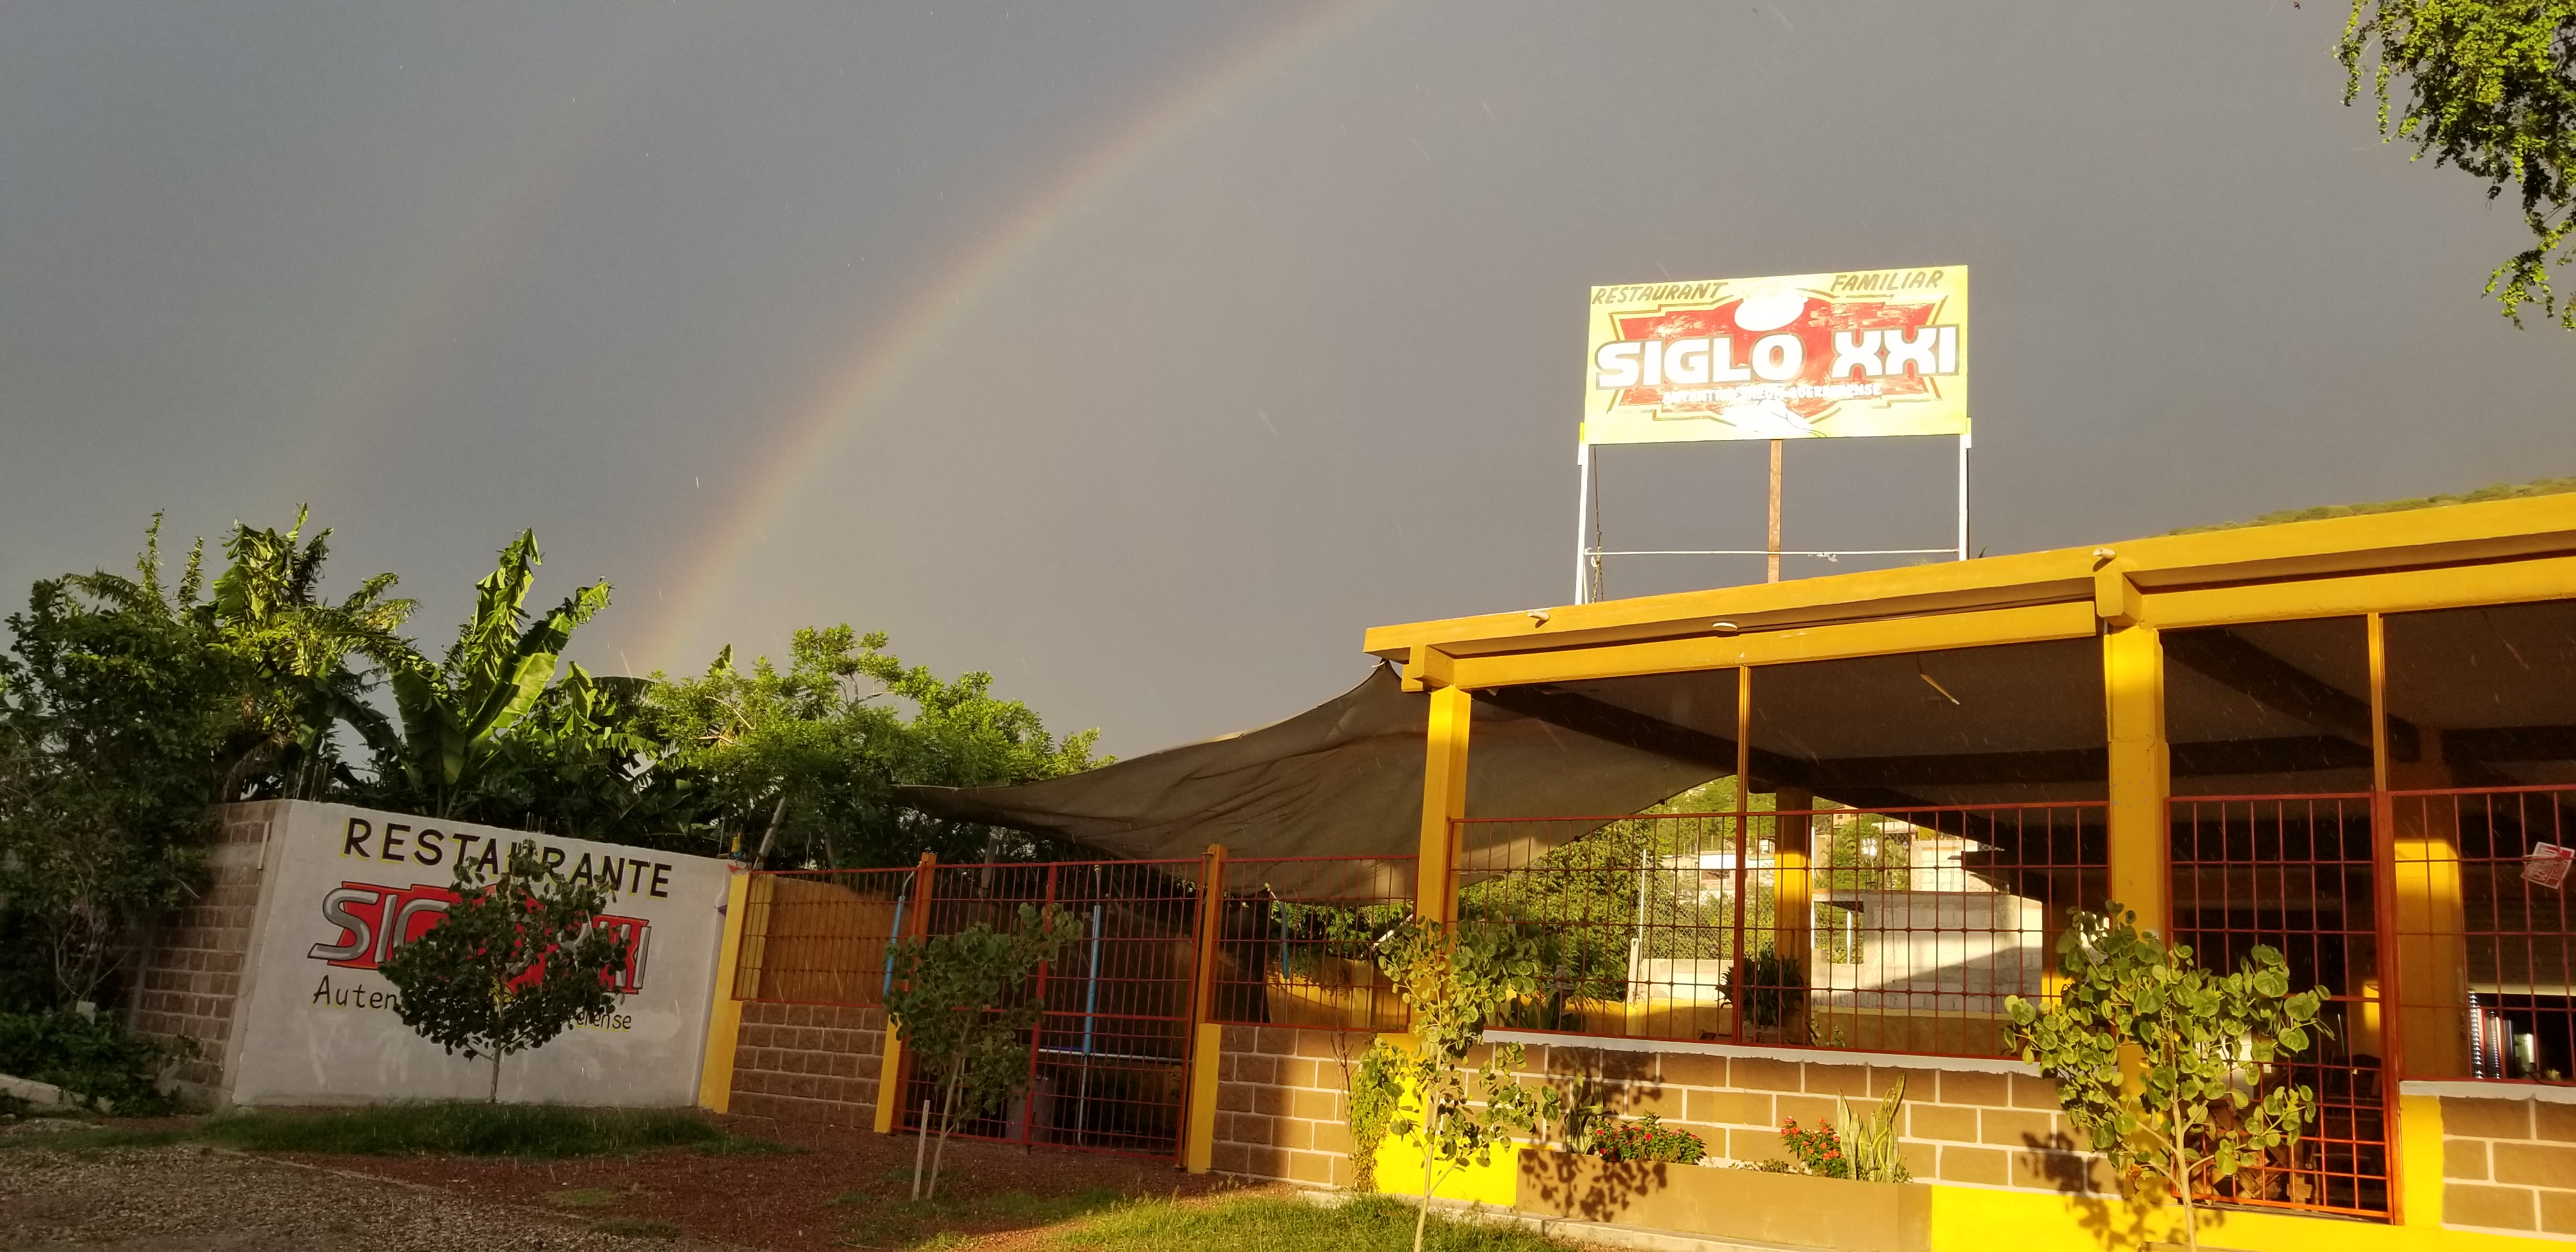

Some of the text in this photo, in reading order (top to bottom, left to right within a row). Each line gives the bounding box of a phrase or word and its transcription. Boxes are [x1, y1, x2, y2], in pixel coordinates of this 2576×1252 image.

[1592, 271, 1943, 305] RESTAURANT FAMILIAR
[1596, 324, 1959, 390] SIGLO XXI
